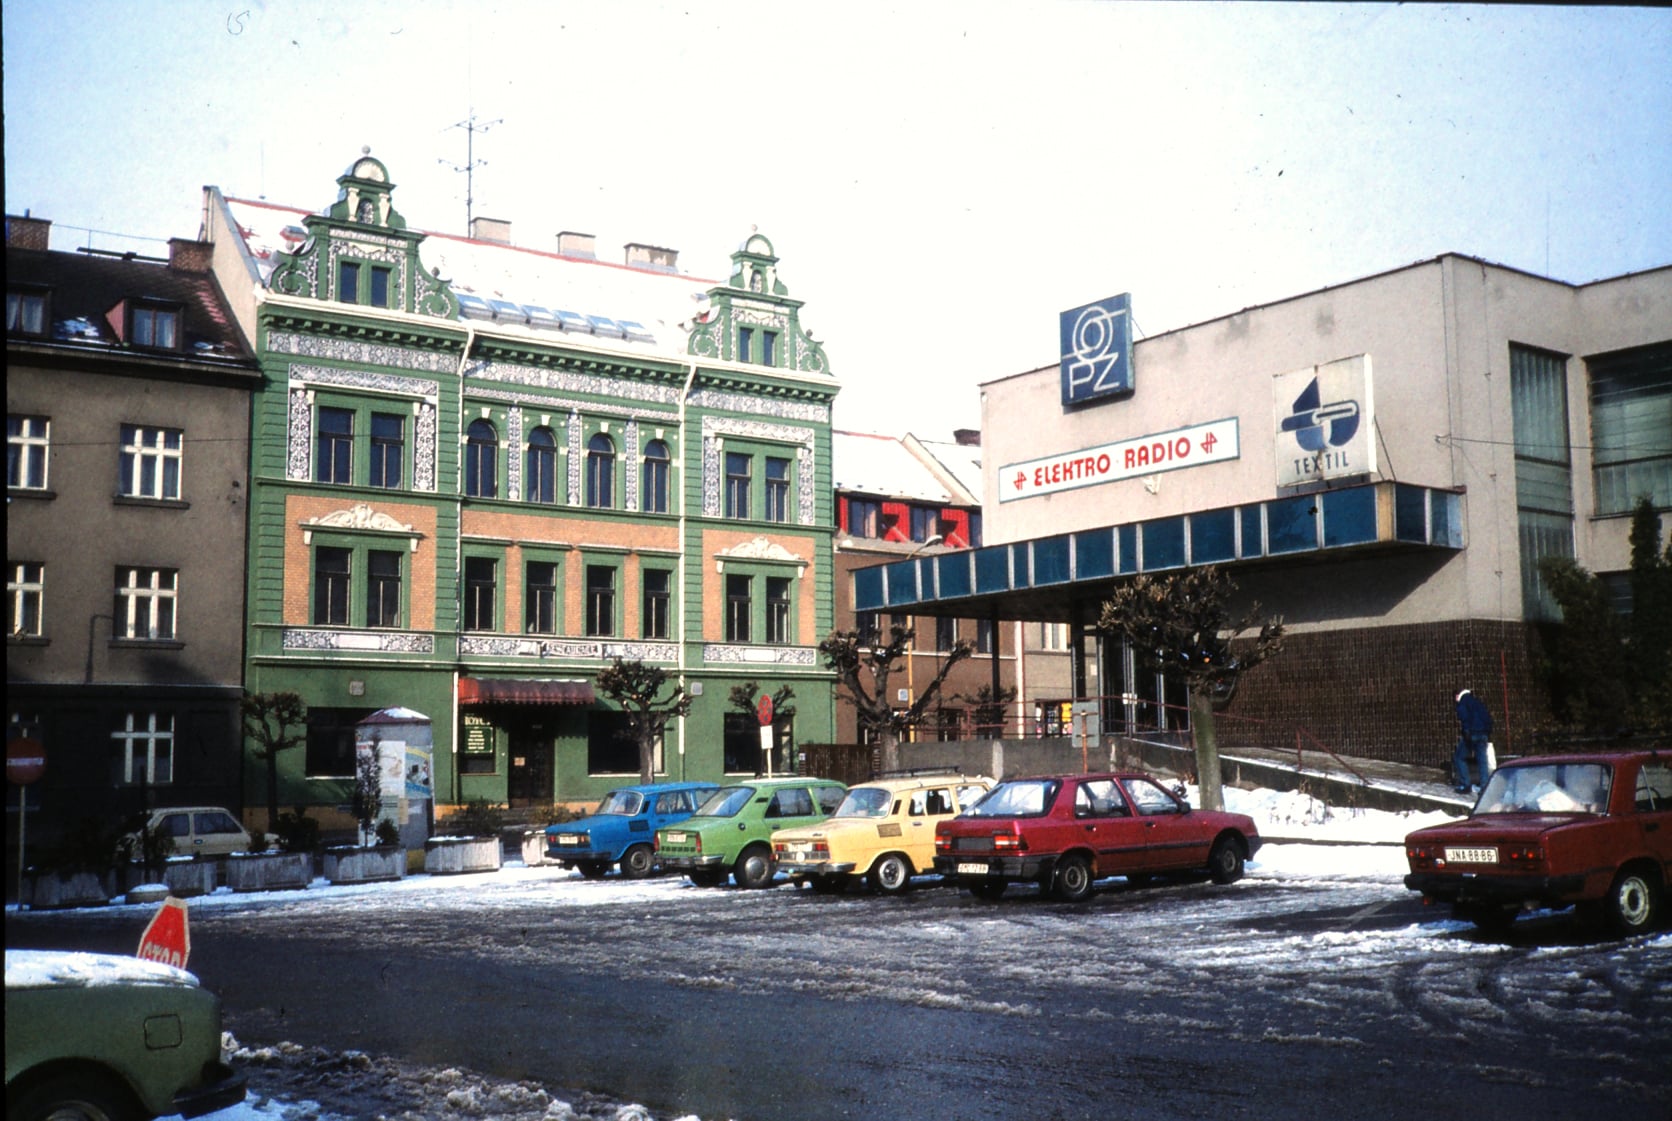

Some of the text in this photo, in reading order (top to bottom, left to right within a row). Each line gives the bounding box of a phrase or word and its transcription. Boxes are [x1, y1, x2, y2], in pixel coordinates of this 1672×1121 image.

[1034, 437, 1191, 487] ELEKTRO RADIO
[1294, 451, 1349, 475] TEXTIL
